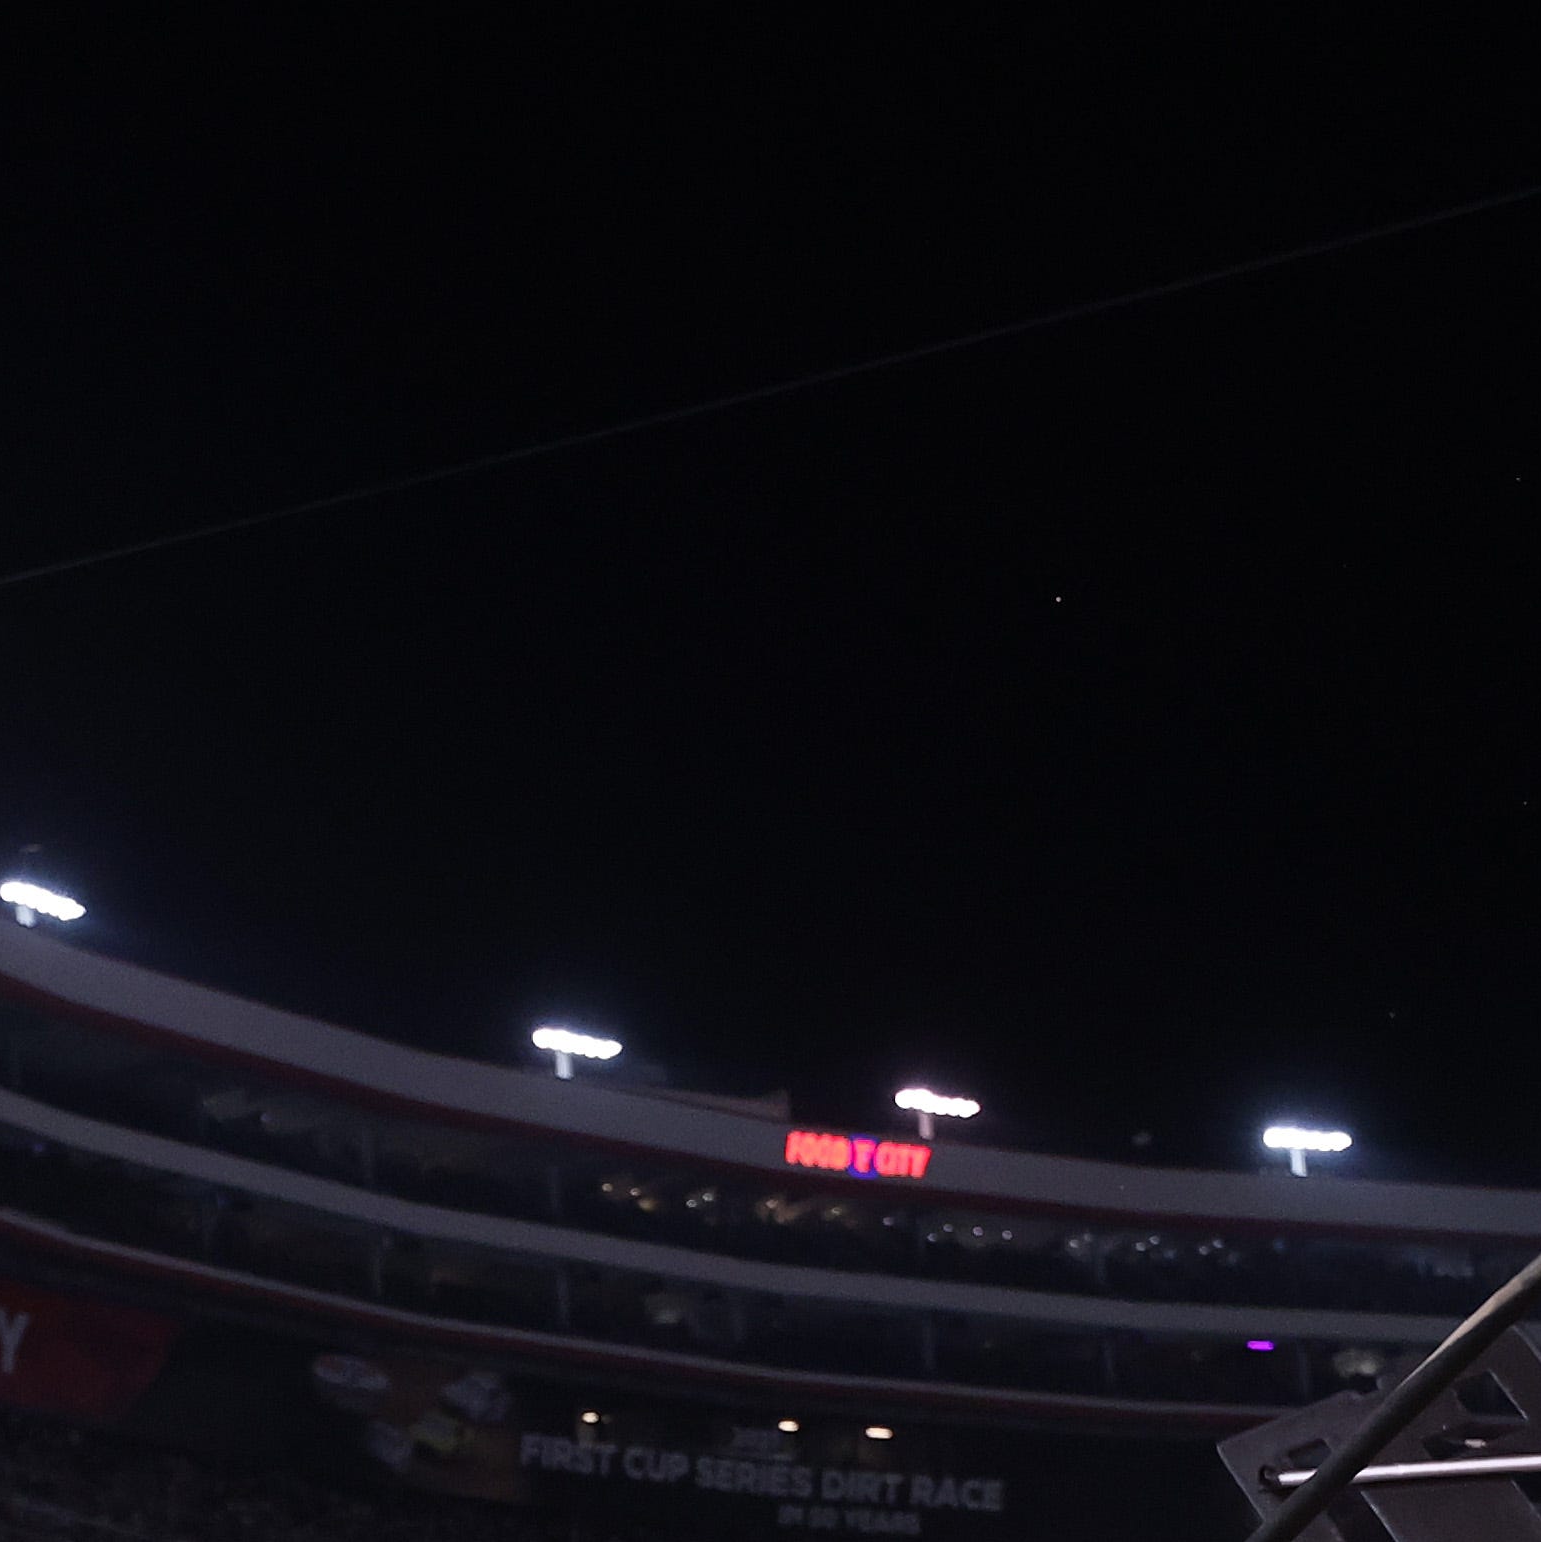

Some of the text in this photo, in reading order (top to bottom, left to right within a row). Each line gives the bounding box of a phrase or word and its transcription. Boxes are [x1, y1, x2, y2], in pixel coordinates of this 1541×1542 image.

[520, 1433, 1005, 1513] FIRST CUP SERIES DIRT RACE
